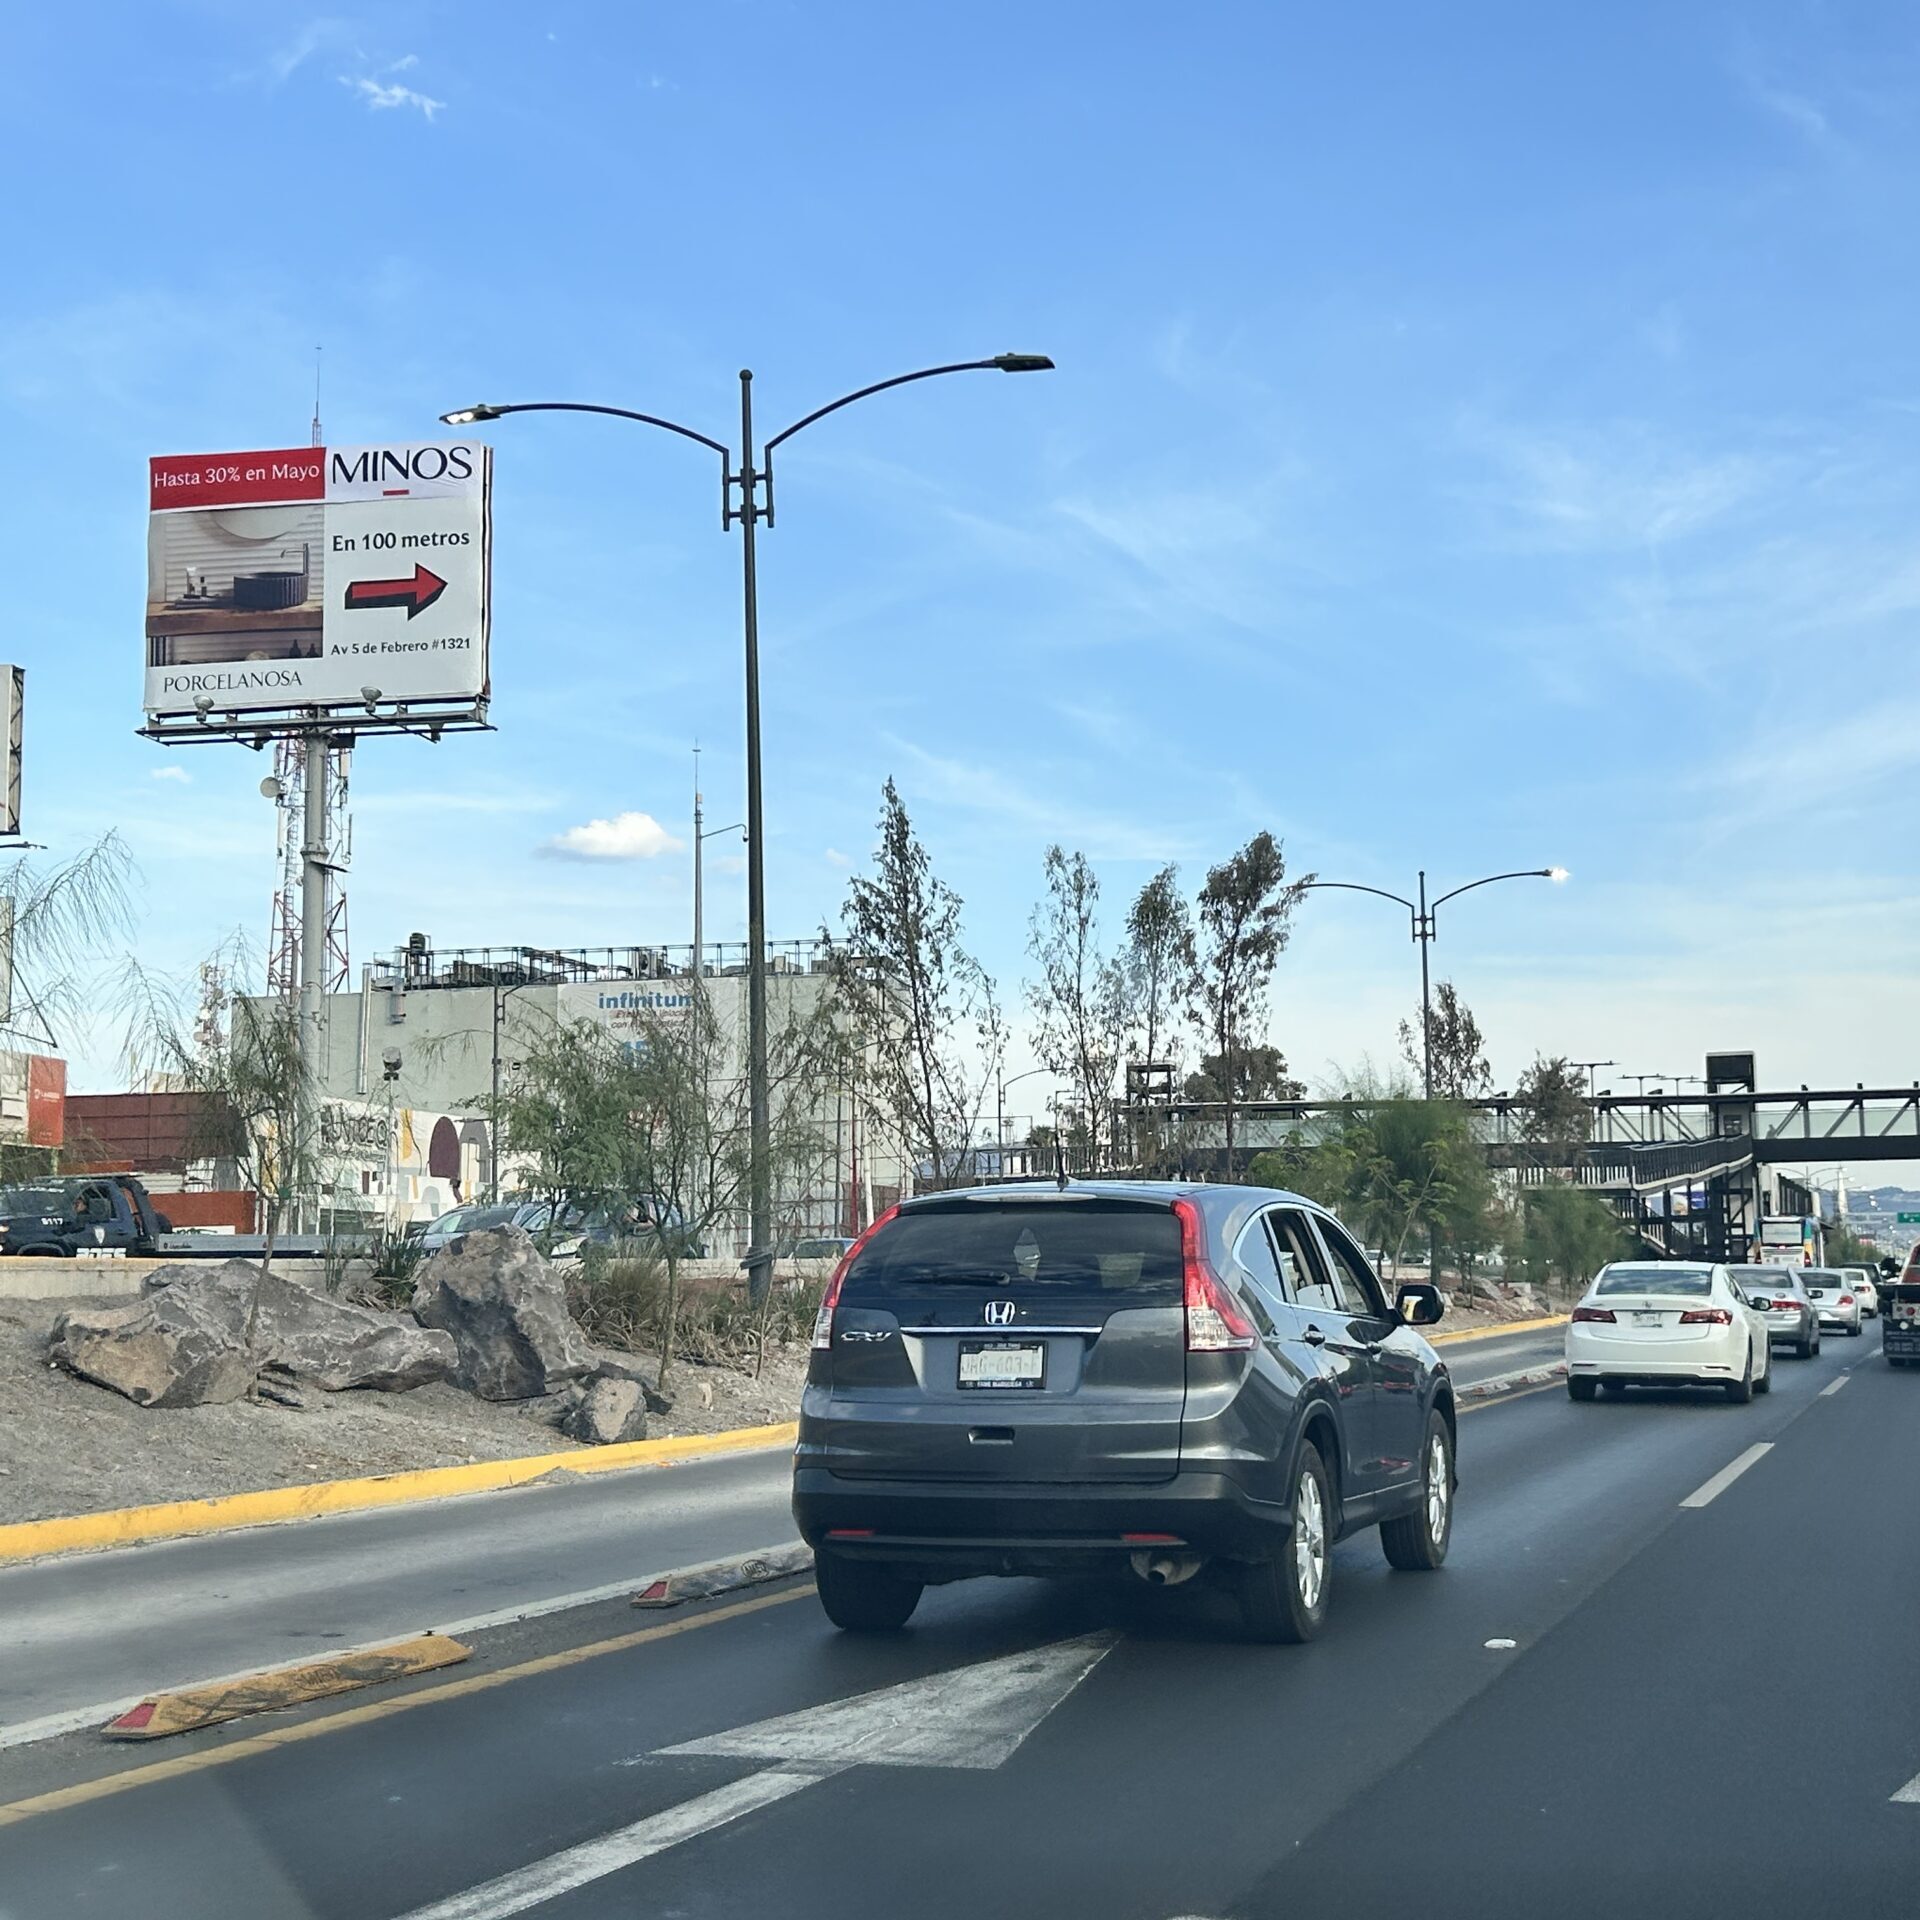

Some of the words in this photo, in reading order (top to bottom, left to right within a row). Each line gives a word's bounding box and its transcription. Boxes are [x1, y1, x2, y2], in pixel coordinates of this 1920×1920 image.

[154, 472, 201, 489] Hasta
[205, 466, 241, 484] 30%
[245, 468, 266, 481] en
[271, 464, 320, 482] Mayo
[332, 446, 473, 484] MINOS
[332, 535, 356, 552] En
[362, 532, 397, 550] 100
[401, 532, 470, 548] metros
[330, 644, 349, 656] Av
[351, 643, 360, 654] 5
[362, 642, 378, 654] de
[381, 641, 429, 653] Febrero
[431, 638, 471, 650] #1321
[164, 670, 303, 693] PORCELANOSA
